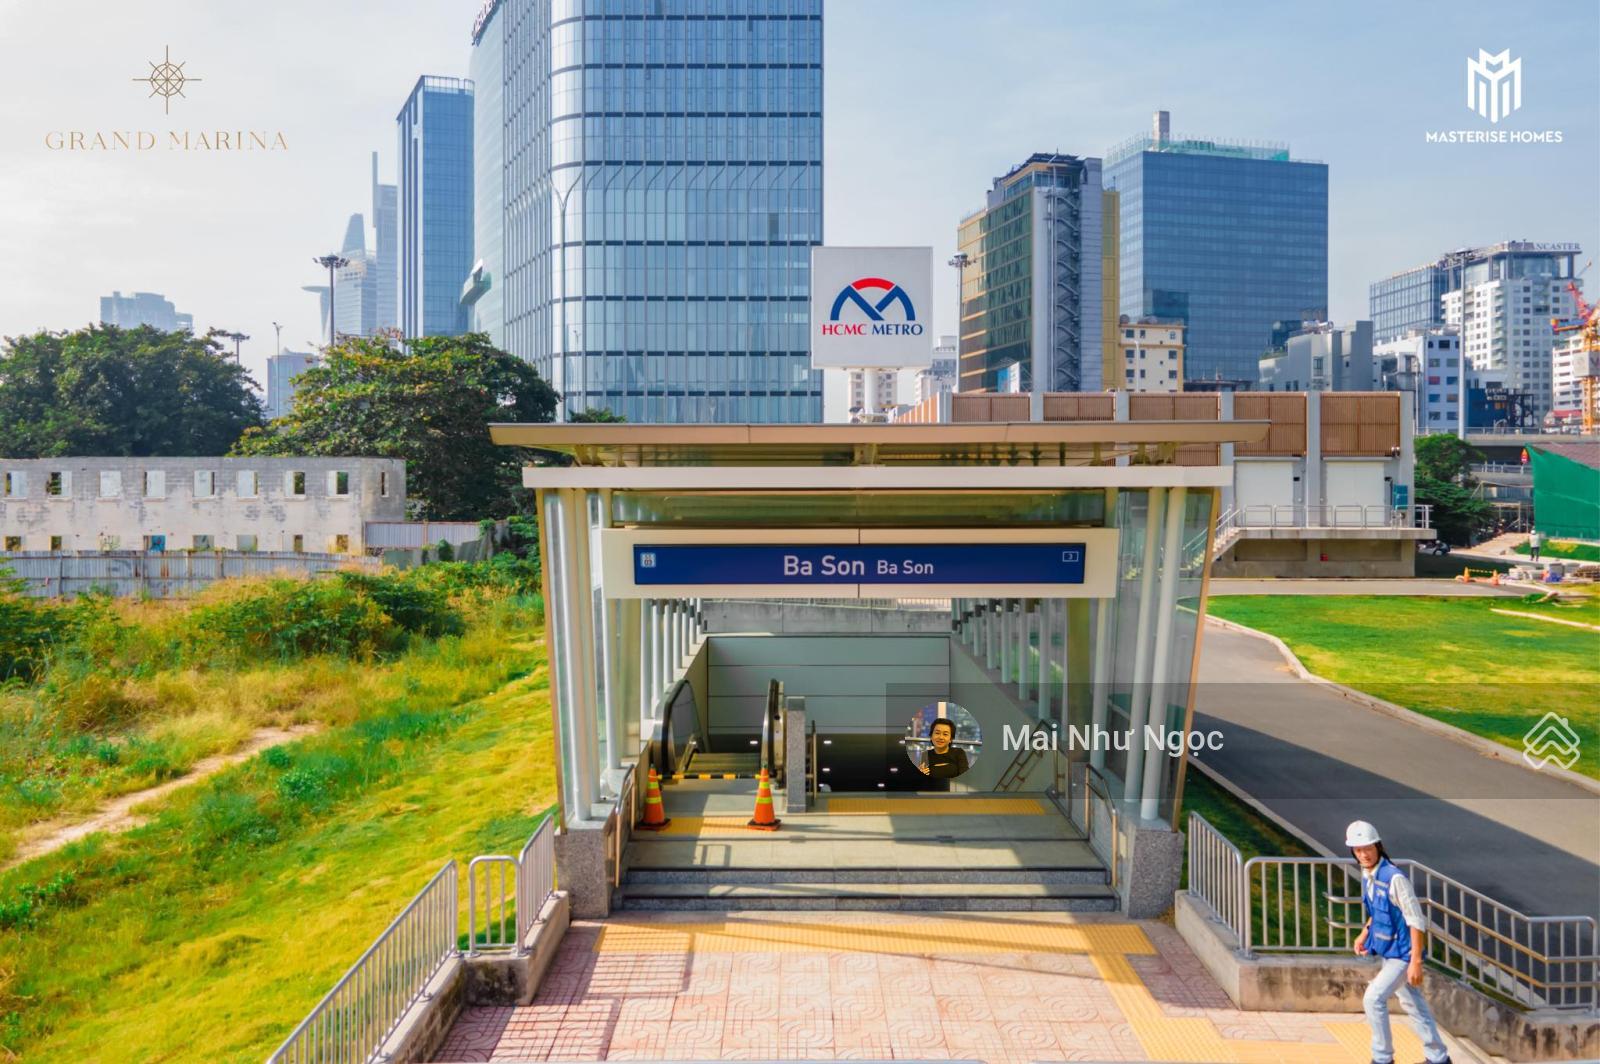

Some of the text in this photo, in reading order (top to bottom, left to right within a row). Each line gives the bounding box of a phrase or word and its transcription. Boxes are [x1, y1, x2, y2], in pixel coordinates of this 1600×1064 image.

[821, 323, 923, 336] HCMC METRO
[783, 554, 934, 576] Ba Son Ba Son
